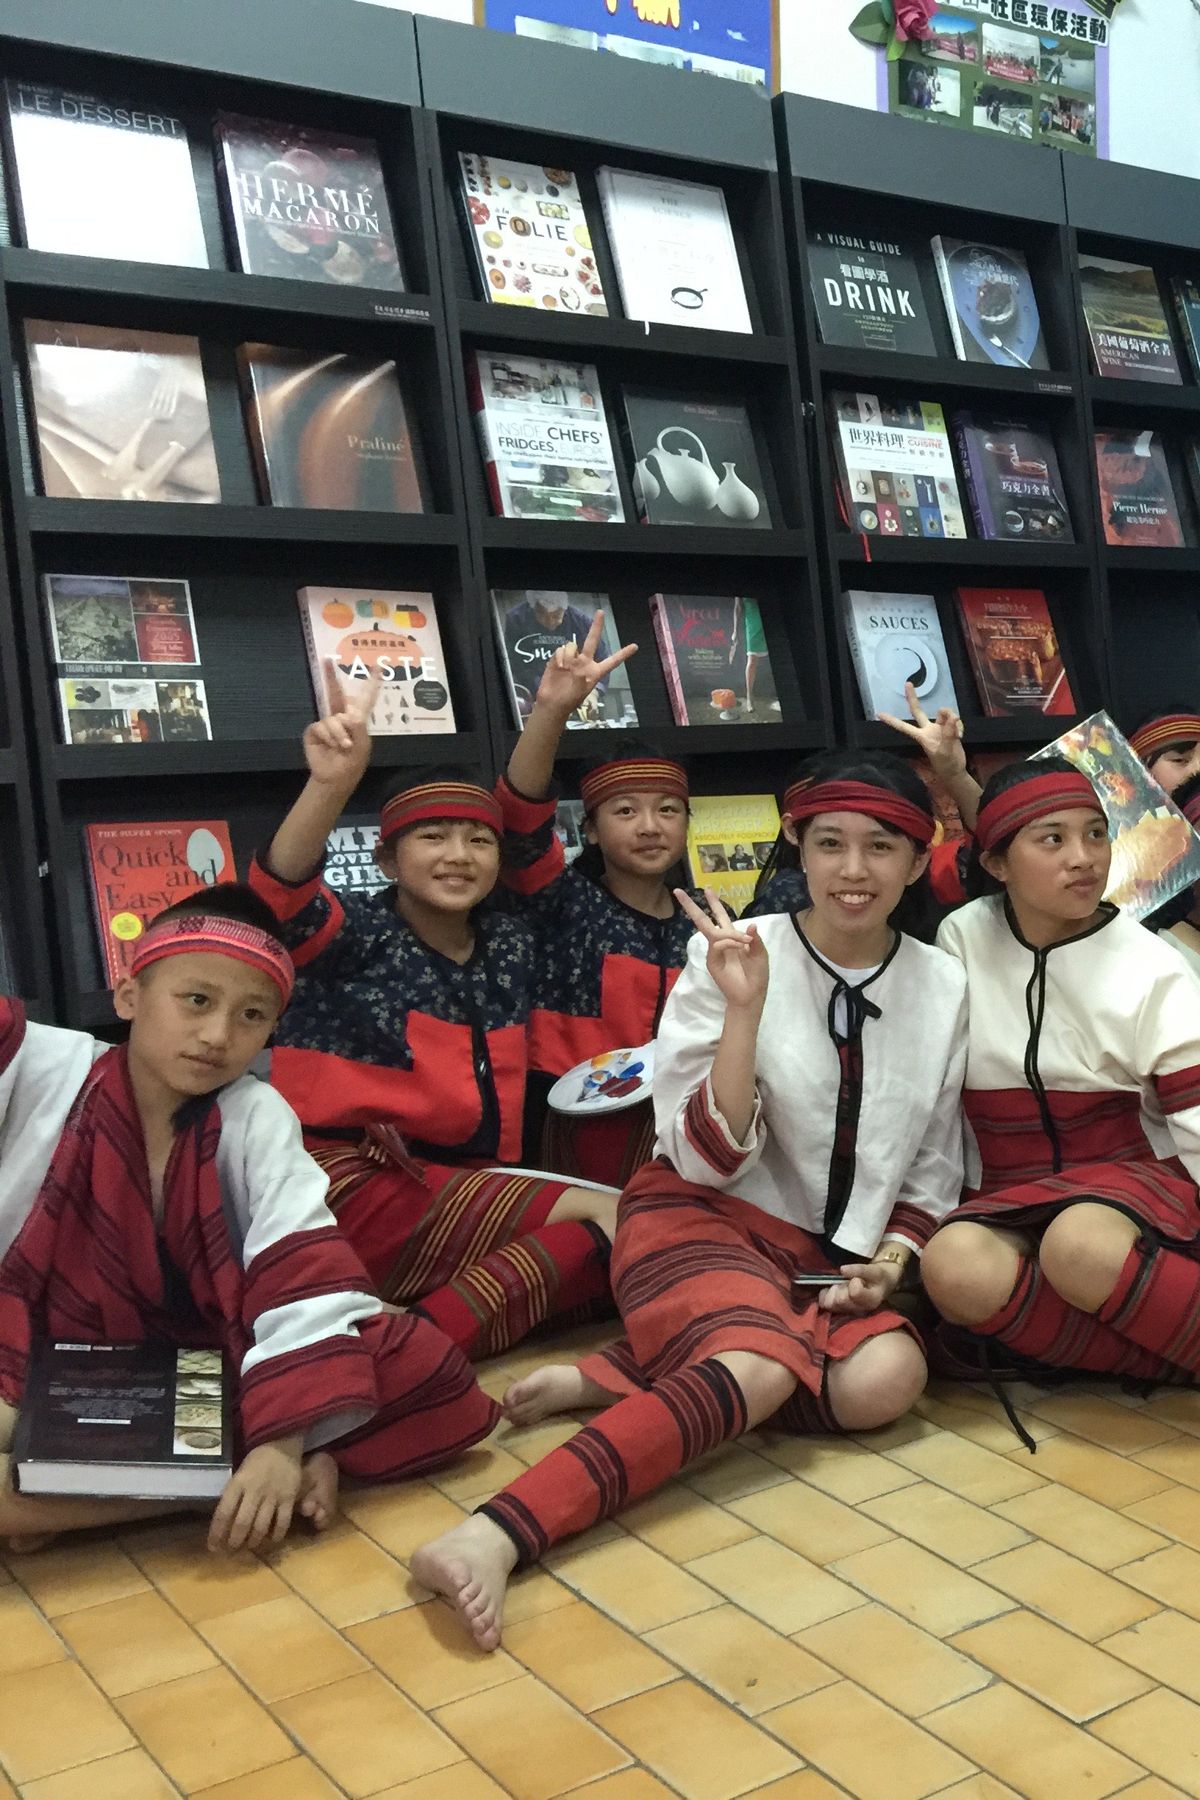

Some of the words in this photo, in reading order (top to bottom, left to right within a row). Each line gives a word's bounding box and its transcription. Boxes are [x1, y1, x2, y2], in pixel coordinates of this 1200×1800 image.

[991, 0, 1107, 44] 社區環保活動
[18, 92, 51, 113] LE
[61, 99, 179, 135] DESSERT
[239, 172, 378, 218] HERMÉ
[243, 197, 380, 233] MACARON
[496, 215, 568, 241] FOLIE
[828, 233, 866, 249] VISUAL
[870, 241, 902, 255] GUIDE
[823, 277, 916, 318] DRINK
[849, 428, 904, 449] 世界料理
[908, 439, 944, 450] CUISINE
[1002, 481, 1050, 497] 巧克力全書
[869, 615, 929, 631] SAUCES
[98, 841, 188, 876] Quick
[166, 858, 217, 888] and
[106, 883, 175, 911] Easy
